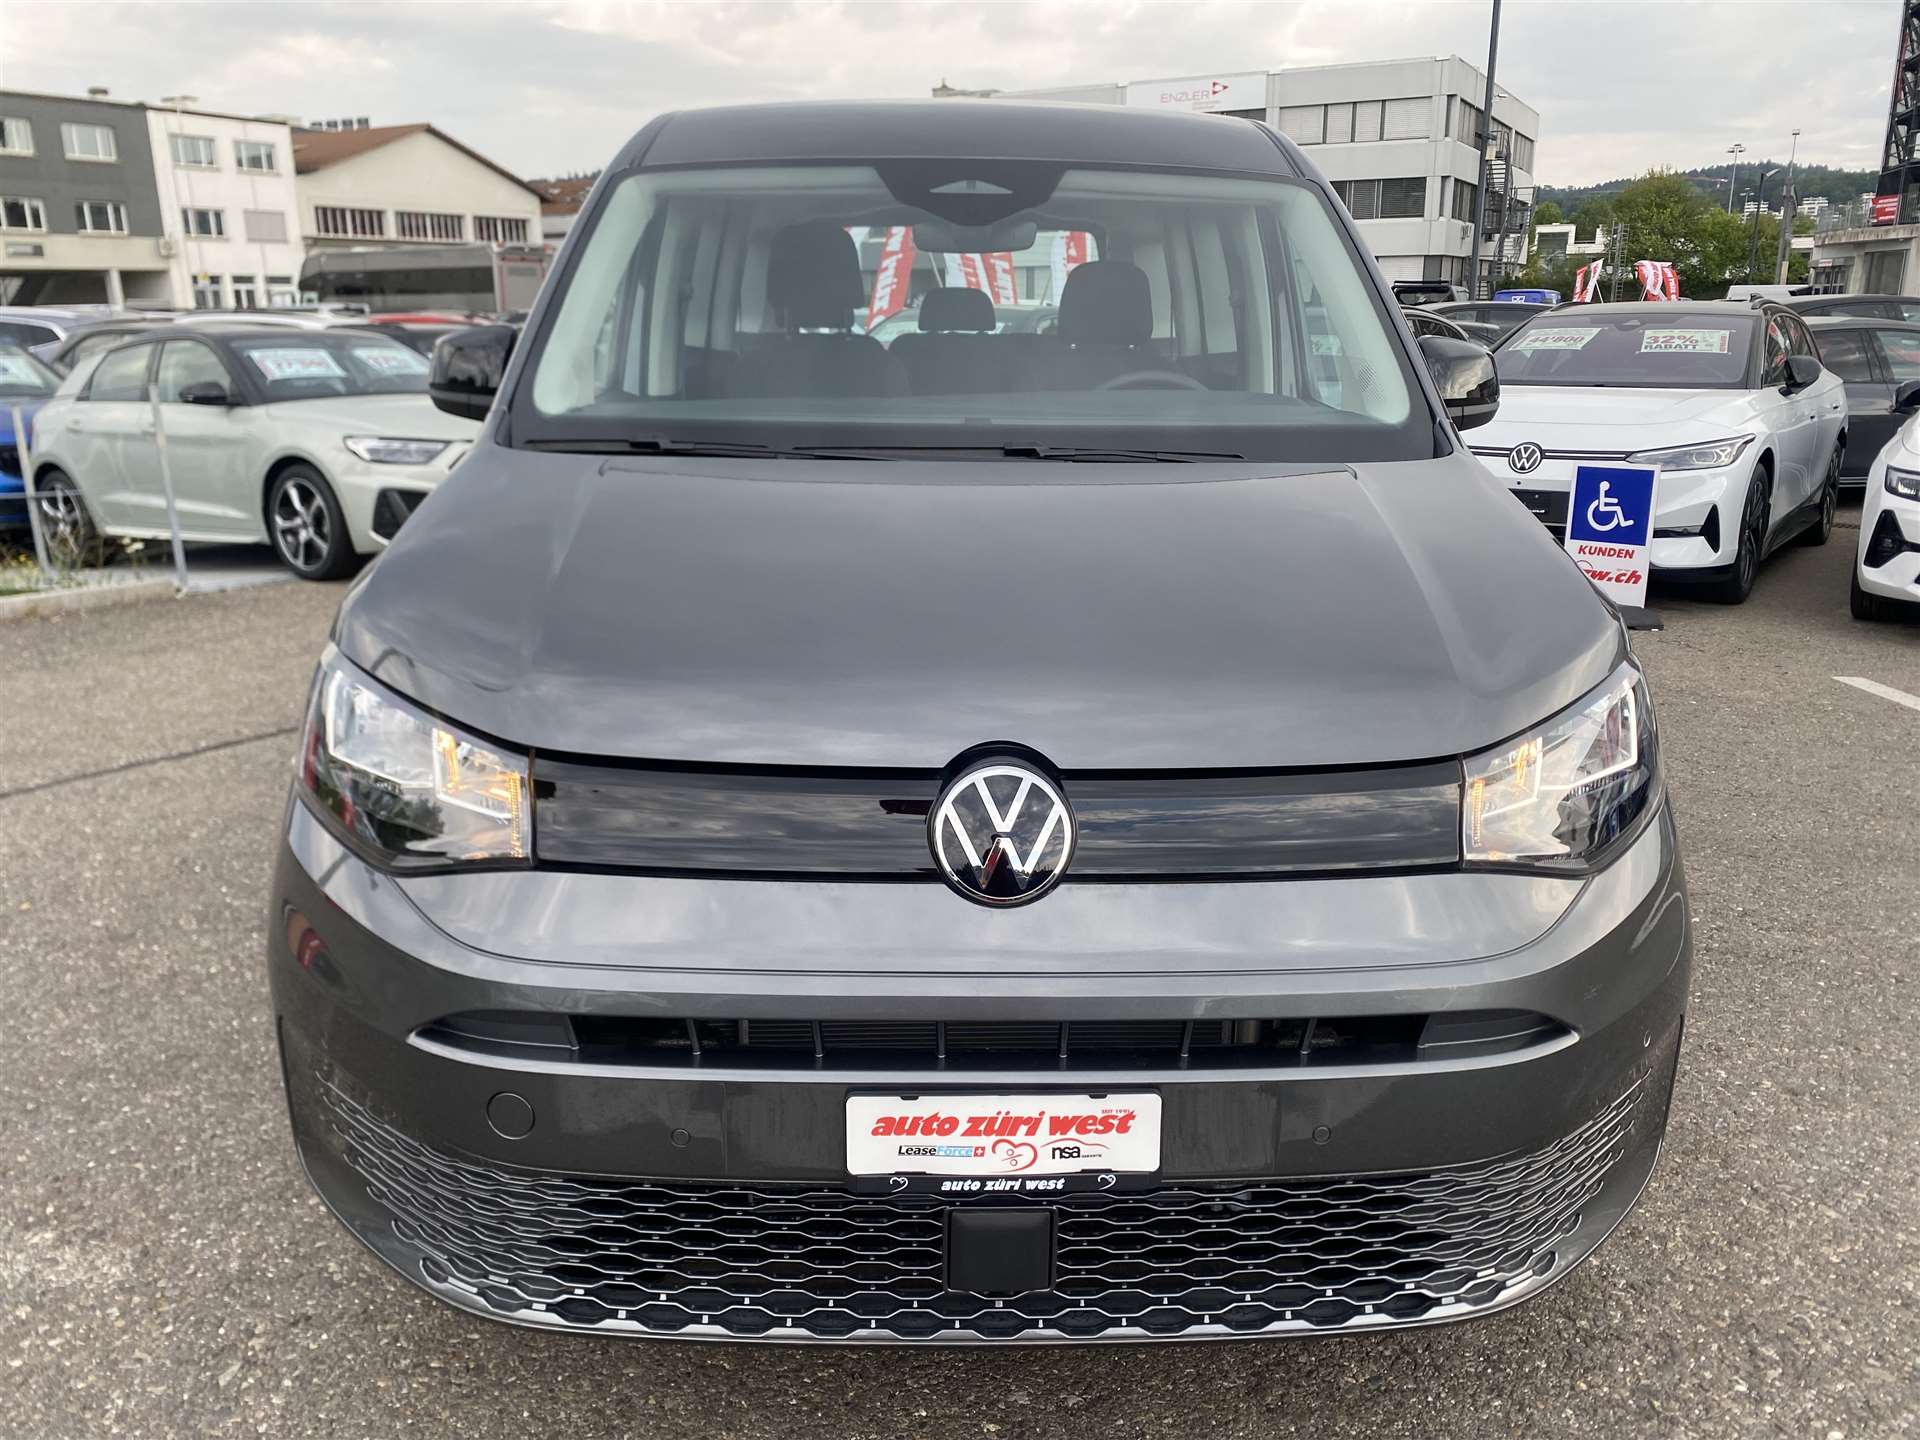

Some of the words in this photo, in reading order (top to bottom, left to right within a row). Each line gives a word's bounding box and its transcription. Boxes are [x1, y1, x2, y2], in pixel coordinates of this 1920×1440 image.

[1160, 89, 1210, 104] ENZLER
[1578, 544, 1635, 559] KUNDEN
[871, 1111, 960, 1136] auto
[960, 1111, 1045, 1136] züri
[1049, 1110, 1136, 1136] west
[1051, 1146, 1081, 1160] nsa
[941, 1180, 981, 1191] auto
[983, 1178, 1022, 1191] züri
[1025, 1178, 1066, 1191] west
